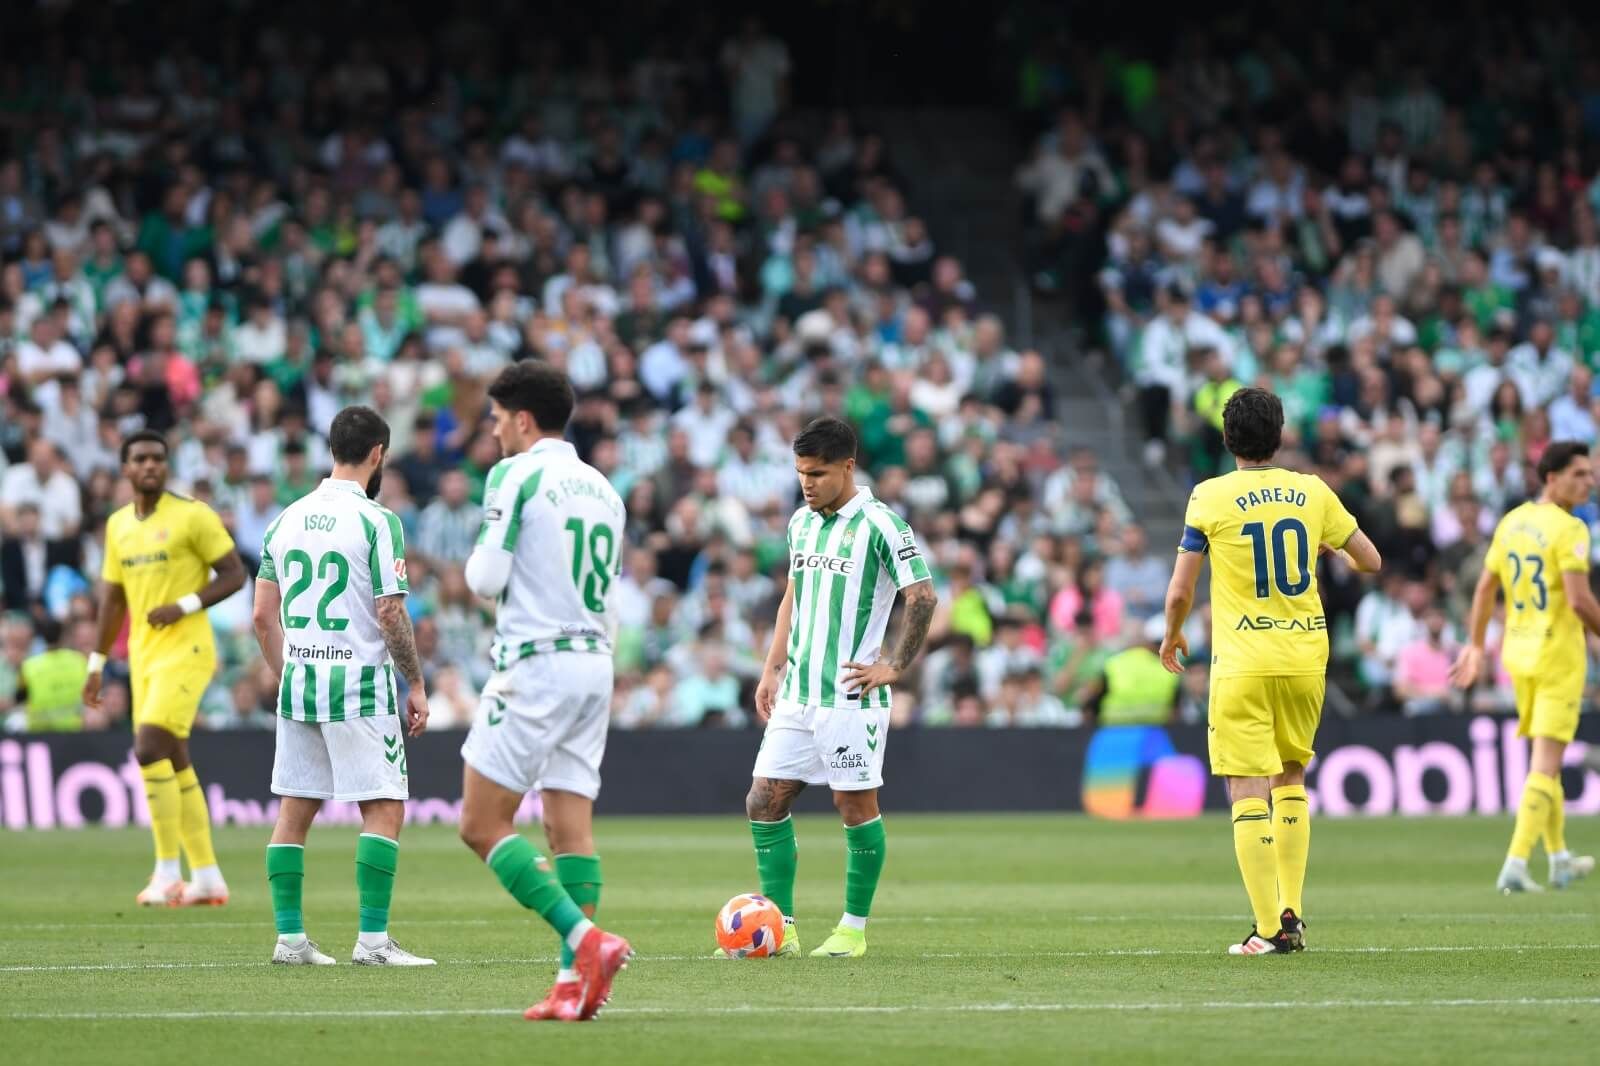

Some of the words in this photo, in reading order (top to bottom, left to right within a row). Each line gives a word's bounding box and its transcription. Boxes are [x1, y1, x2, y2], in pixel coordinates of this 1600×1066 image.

[1235, 487, 1307, 511] PAREJO
[304, 514, 337, 532] ISCO
[564, 516, 613, 613] 18
[806, 555, 855, 574] GREE
[1240, 518, 1311, 598] 10
[283, 549, 350, 631] 22
[1508, 550, 1548, 611] 23
[830, 760, 869, 769] GLOBAL
[841, 753, 863, 761] AUS
[1302, 715, 1600, 817] opil
